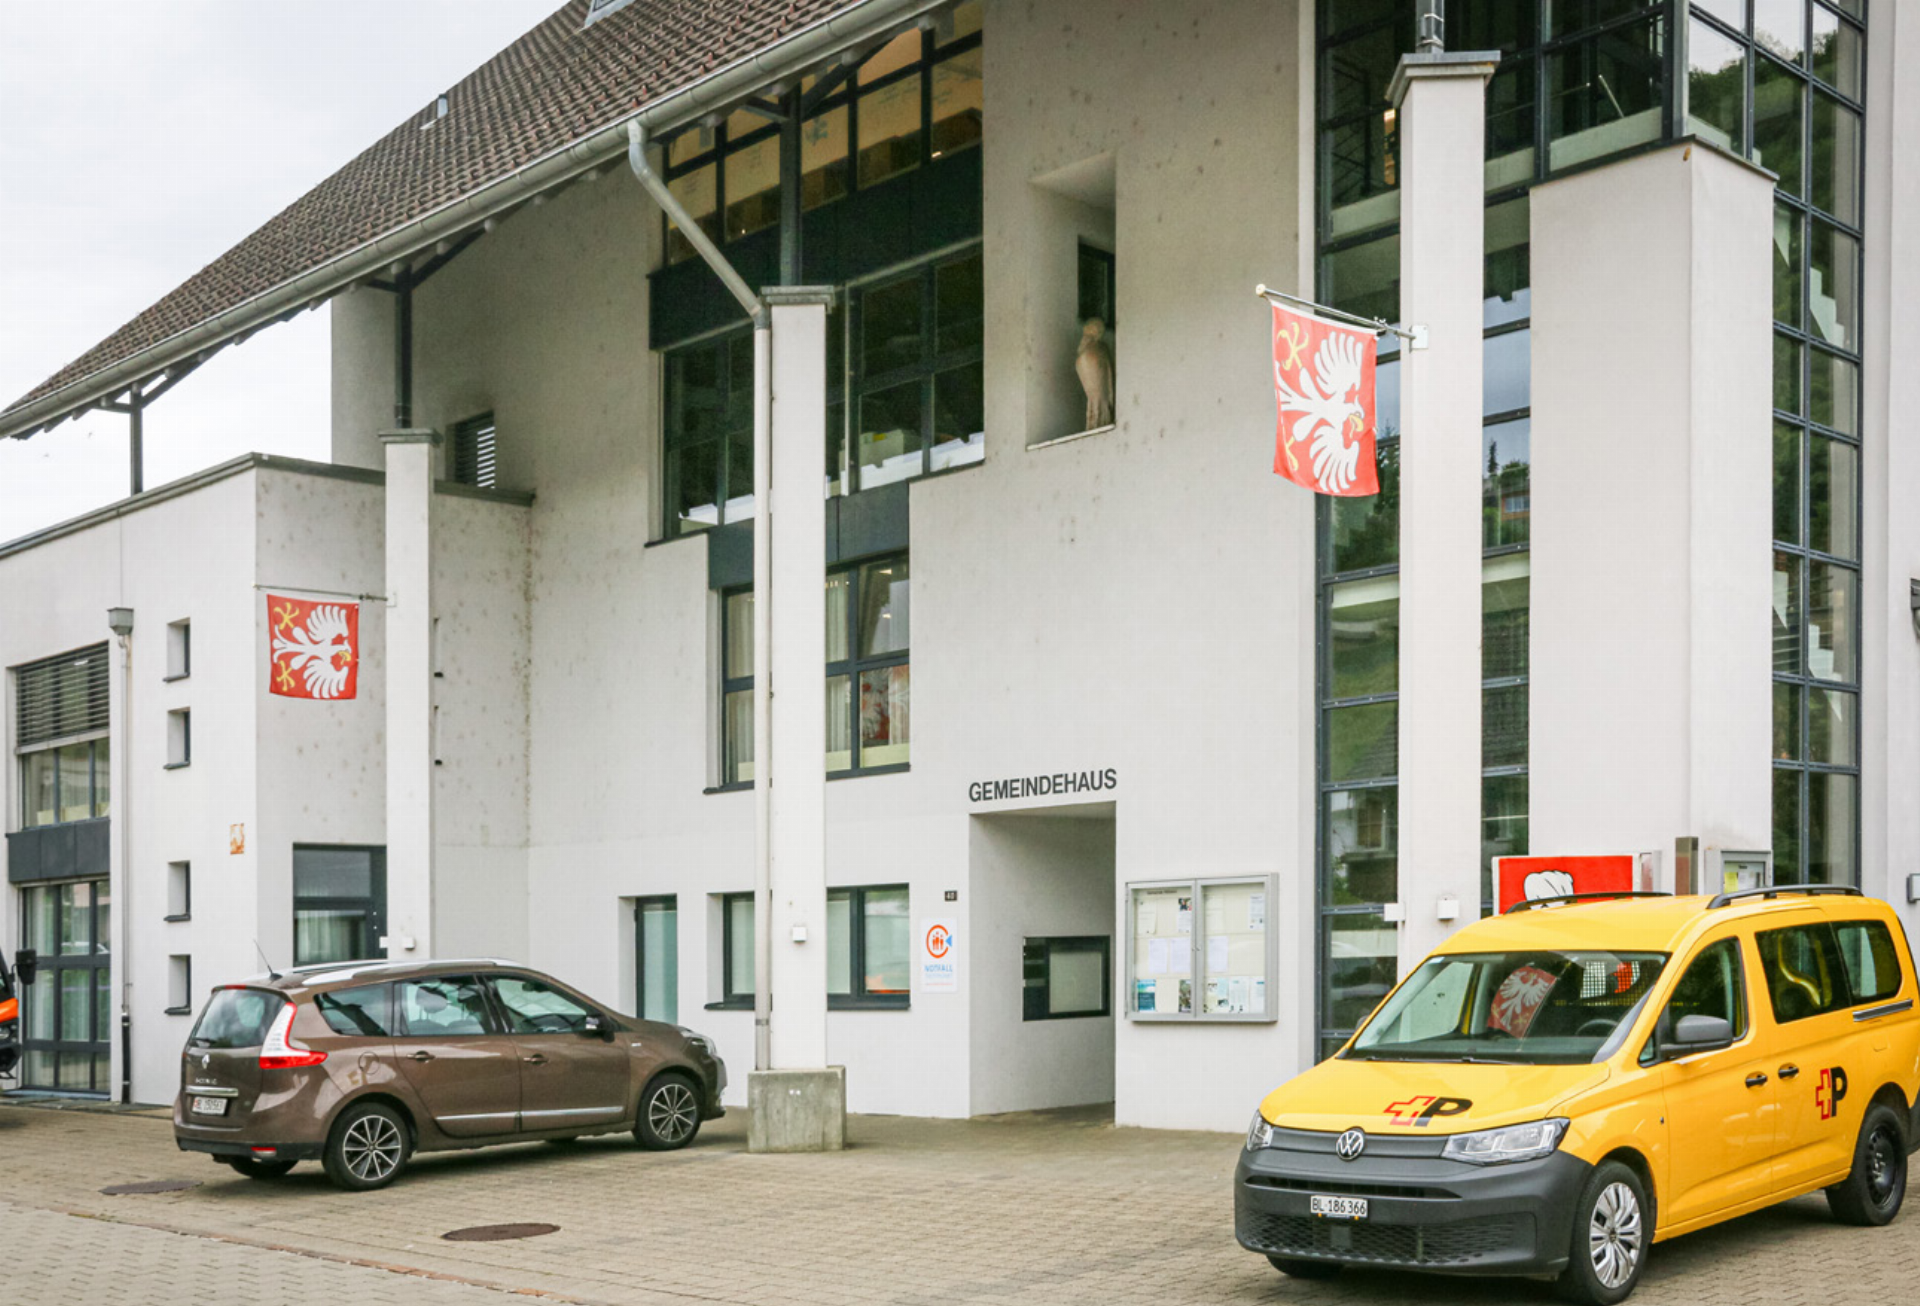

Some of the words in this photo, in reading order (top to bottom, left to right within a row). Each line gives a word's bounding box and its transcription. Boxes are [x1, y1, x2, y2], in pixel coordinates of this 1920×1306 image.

[968, 768, 1117, 802] GEMEINDEHAUS
[924, 964, 953, 972] NOTFALL
[1312, 1197, 1325, 1212] BL
[1328, 1199, 1346, 1213] 186
[1347, 1200, 1366, 1215] 366
